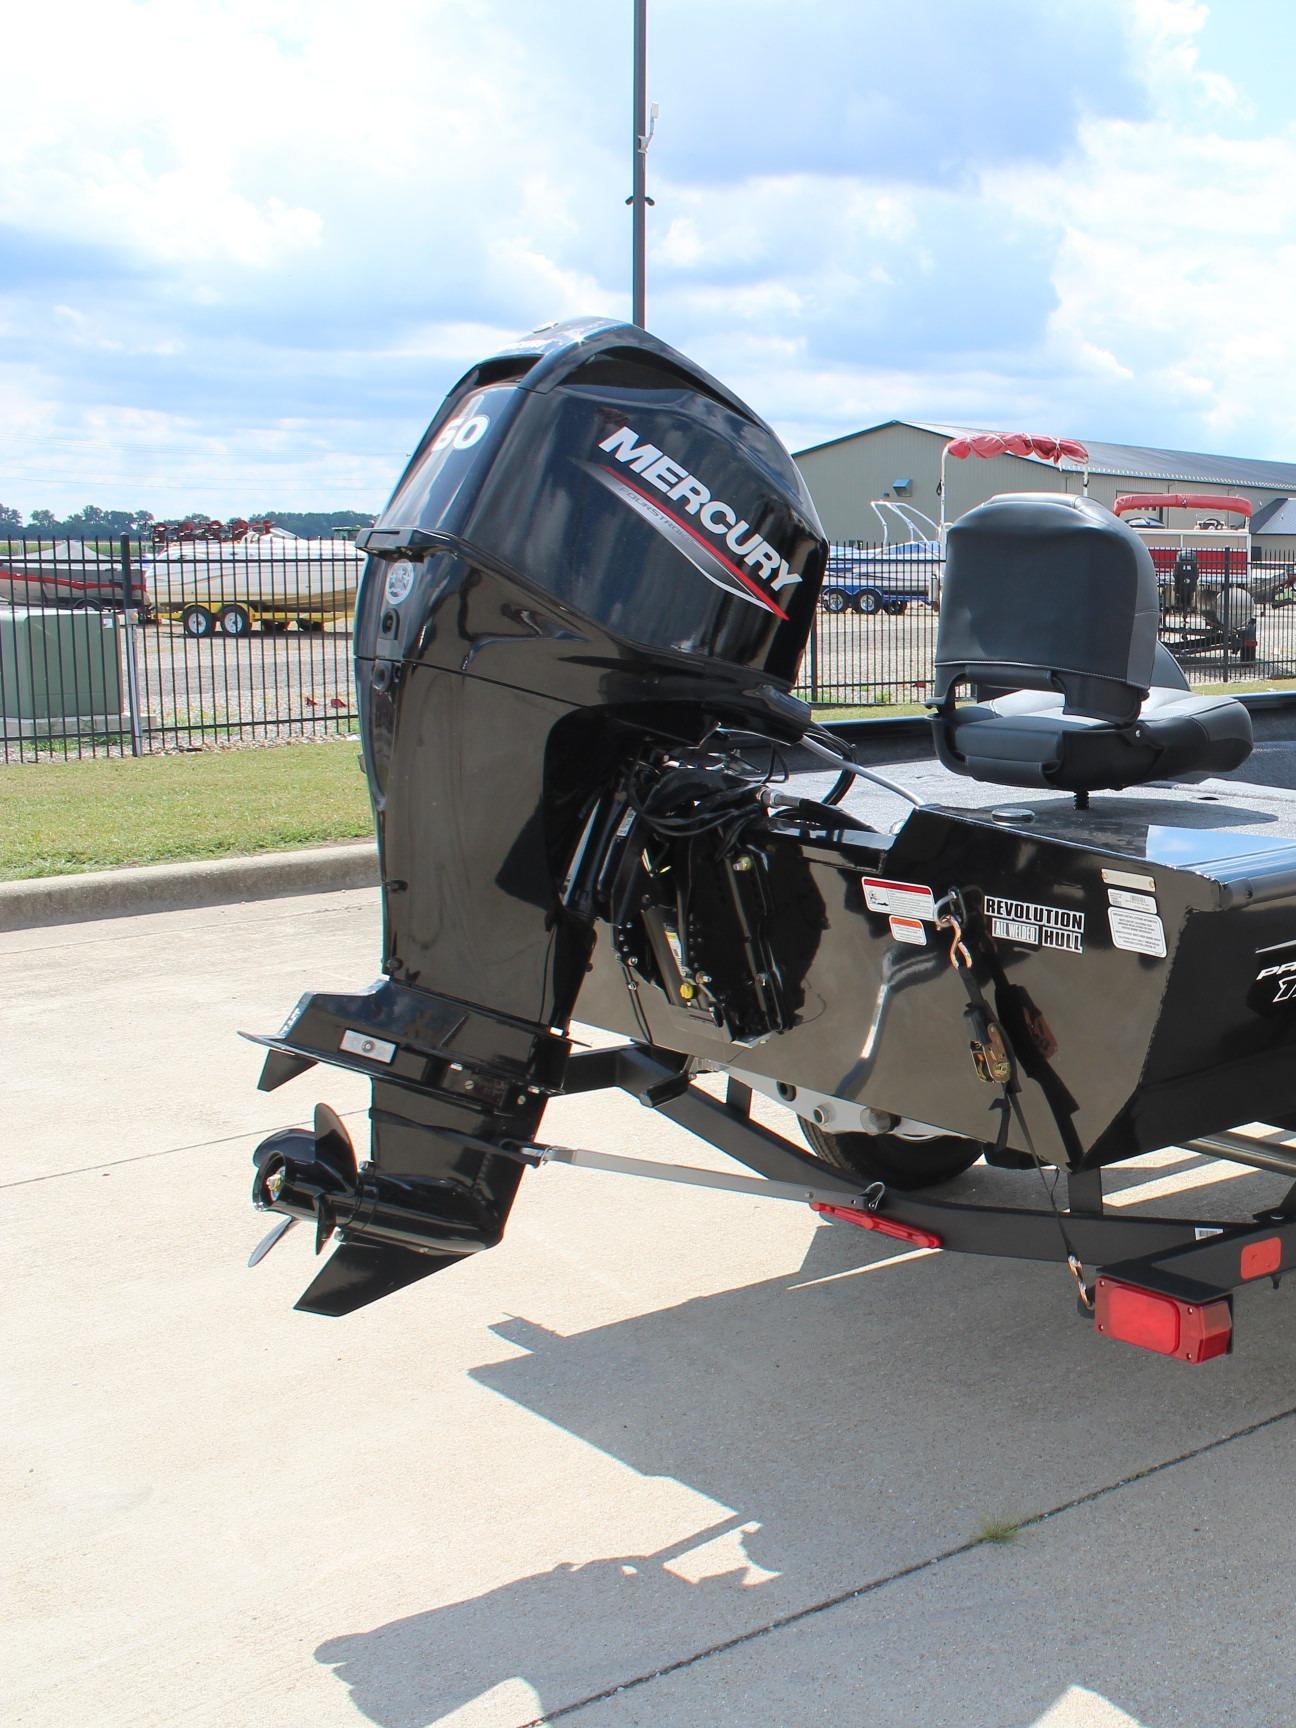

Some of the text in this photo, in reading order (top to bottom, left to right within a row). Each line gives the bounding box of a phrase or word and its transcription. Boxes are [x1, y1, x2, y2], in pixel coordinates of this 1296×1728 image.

[599, 426, 803, 591] MERCURY
[985, 897, 1083, 931] REVOLUTION
[995, 920, 1036, 942] ALL WELDED
[1044, 929, 1082, 951] HULL
